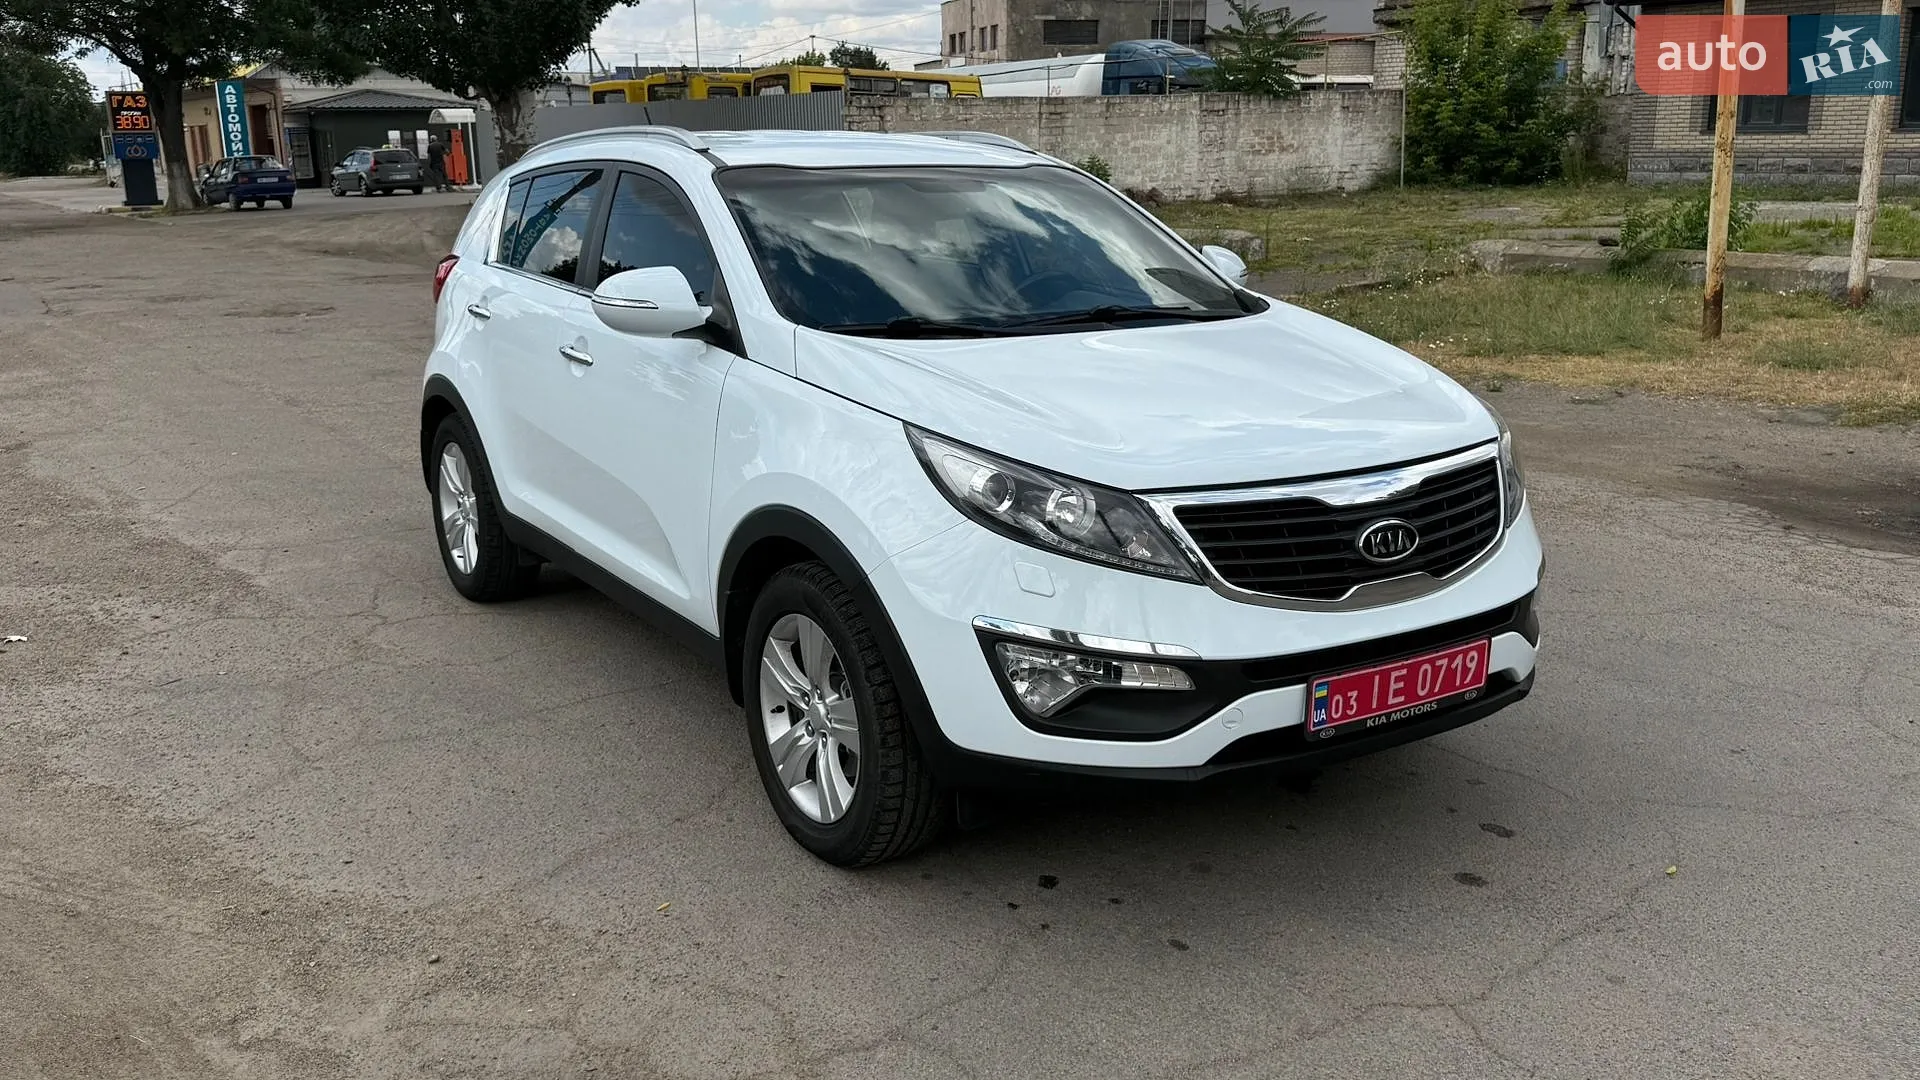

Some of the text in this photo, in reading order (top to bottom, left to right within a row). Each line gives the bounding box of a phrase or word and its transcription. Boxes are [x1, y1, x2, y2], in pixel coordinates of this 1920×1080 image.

[111, 95, 147, 108] ГАЗ
[1369, 528, 1411, 555] KIA
[1331, 650, 1479, 719] 03 IE 0719
[1313, 708, 1327, 723] UA
[1366, 701, 1438, 728] KIA MOTORS
